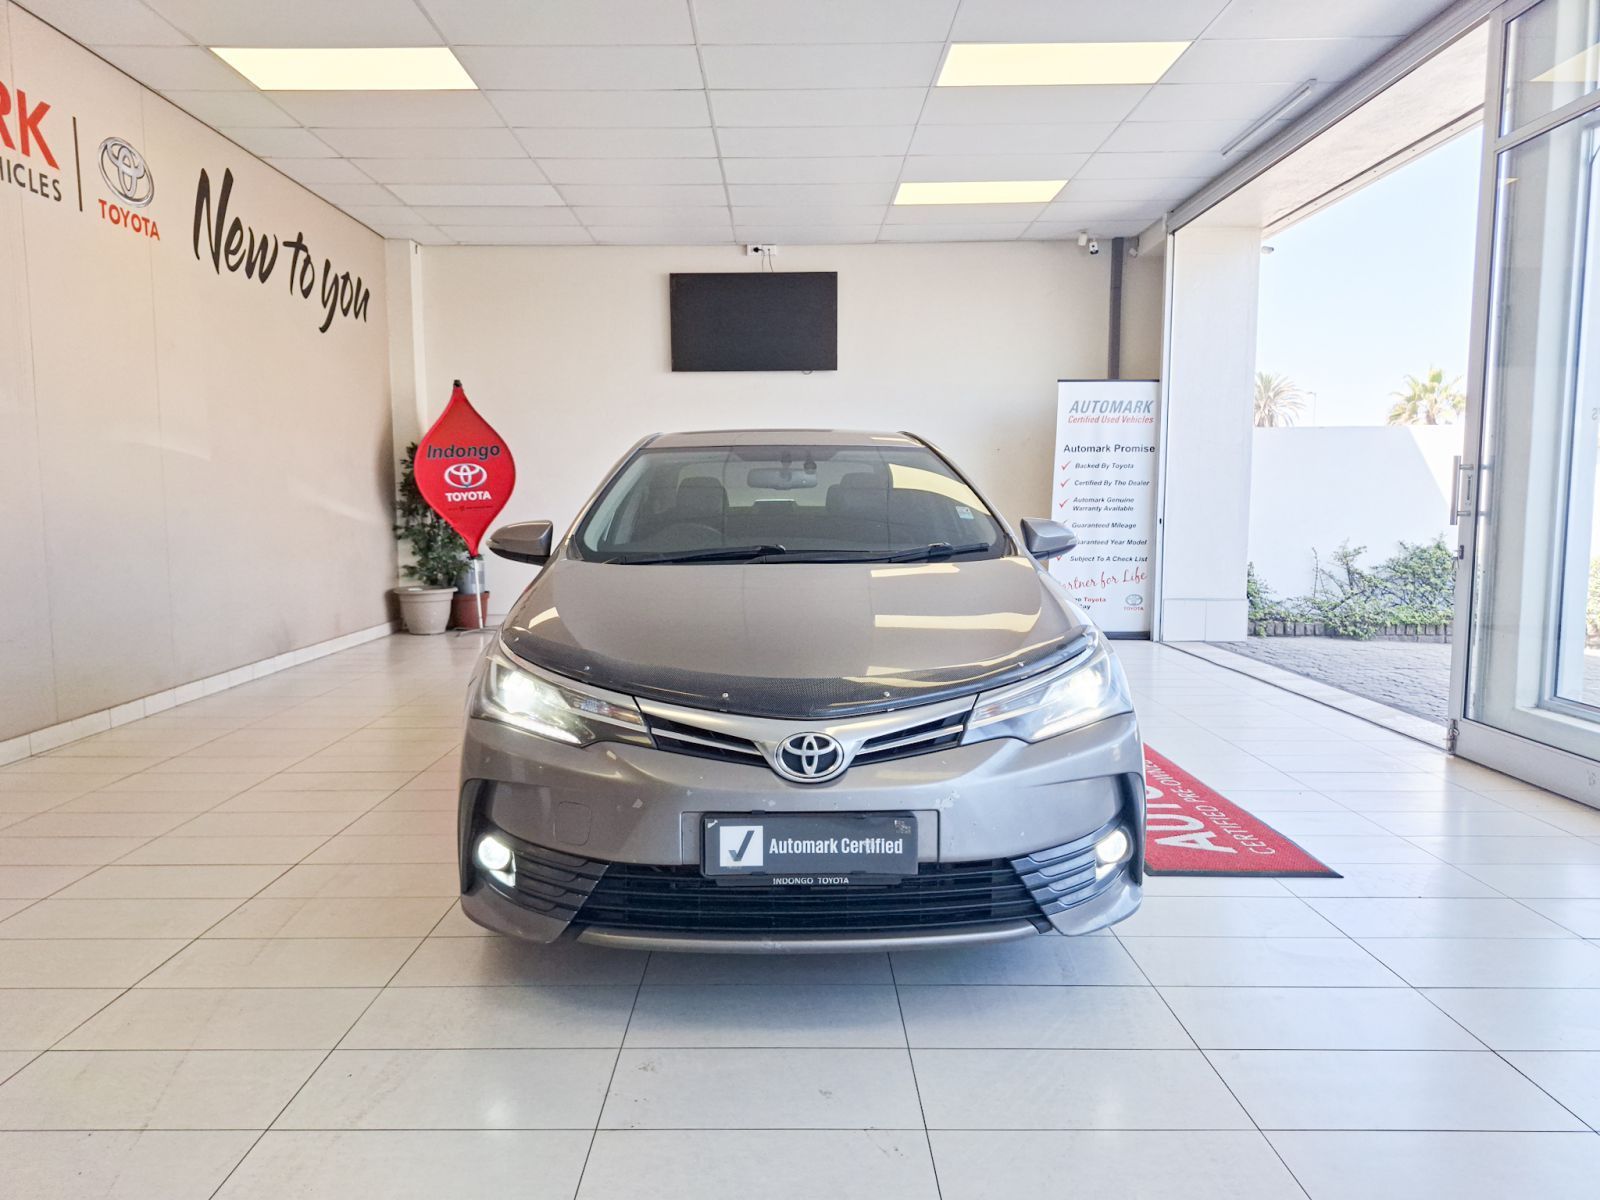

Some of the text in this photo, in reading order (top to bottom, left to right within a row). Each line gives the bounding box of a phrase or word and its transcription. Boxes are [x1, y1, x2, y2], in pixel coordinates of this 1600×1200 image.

[98, 199, 160, 241] TOYOTA
[193, 167, 370, 333] New to you
[1068, 400, 1154, 414] AUTOMARK
[1068, 415, 1154, 424] Certified Used Vehicles
[427, 445, 500, 460] Indongo
[1064, 444, 1156, 453] Automark Promise
[1101, 463, 1110, 471] By
[1112, 463, 1134, 471] Toyota
[1103, 480, 1112, 488] By
[445, 490, 492, 502] TOYOTA
[1110, 522, 1137, 530] Mileage
[1070, 555, 1095, 563] Subject
[1196, 805, 1276, 854] CERTIFIED
[769, 837, 903, 854] Automark Certified
[773, 877, 814, 885] INDONGO
